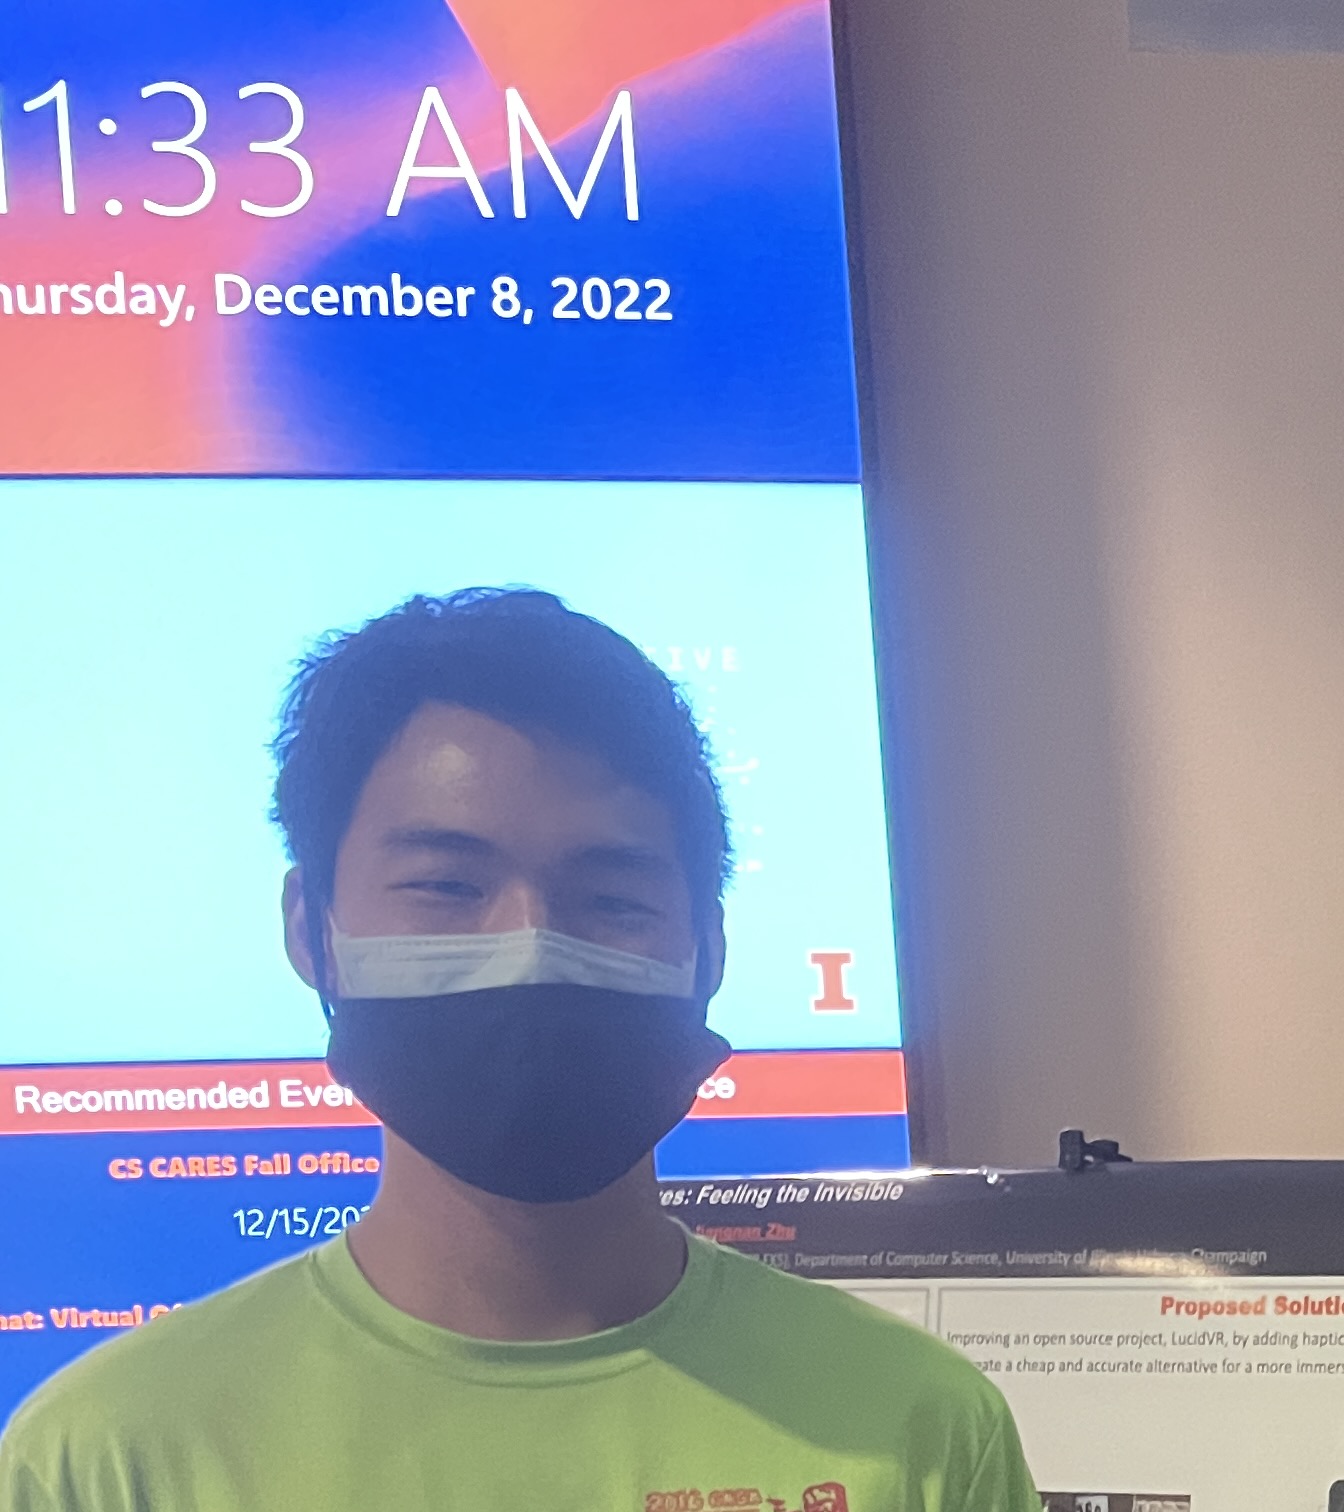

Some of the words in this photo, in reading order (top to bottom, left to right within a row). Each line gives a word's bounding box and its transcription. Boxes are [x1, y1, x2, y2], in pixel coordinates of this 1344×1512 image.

[0, 79, 314, 218] 1:33
[386, 86, 639, 221] AM
[214, 272, 475, 317] December
[491, 276, 534, 325] 8,
[551, 277, 673, 321] 2022
[810, 951, 856, 1013] I
[14, 1080, 270, 1114] Recommended
[108, 1157, 144, 1180] CS
[150, 1155, 237, 1178] CARES
[244, 1153, 291, 1176] Fall
[297, 1151, 381, 1174] Office
[696, 1183, 773, 1209] Feeling
[776, 1184, 810, 1203] the
[813, 1181, 904, 1202] Invisible
[233, 1205, 371, 1239] 12/15/20
[794, 1253, 868, 1269] Department
[870, 1251, 885, 1266] of
[885, 1251, 949, 1268] Computer
[951, 1251, 1003, 1267] Science,
[1006, 1249, 1071, 1267] University
[50, 1303, 143, 1329] Virtual
[1160, 1295, 1267, 1320] Proposed
[947, 1331, 1010, 1348] Improving
[1014, 1334, 1030, 1345] an
[1033, 1334, 1066, 1349] open
[1070, 1334, 1113, 1345] source
[1116, 1331, 1168, 1348] project,
[1171, 1331, 1229, 1348] LucidVR,
[1232, 1330, 1249, 1349] by
[1252, 1330, 1299, 1349] adding
[1005, 1361, 1013, 1372] a
[1016, 1358, 1055, 1376] cheap
[1058, 1358, 1084, 1373] and
[1086, 1358, 1142, 1373] accurate
[1146, 1357, 1218, 1374] alternative
[1222, 1358, 1241, 1374] for
[1244, 1361, 1253, 1374] a
[1256, 1361, 1293, 1374] more
